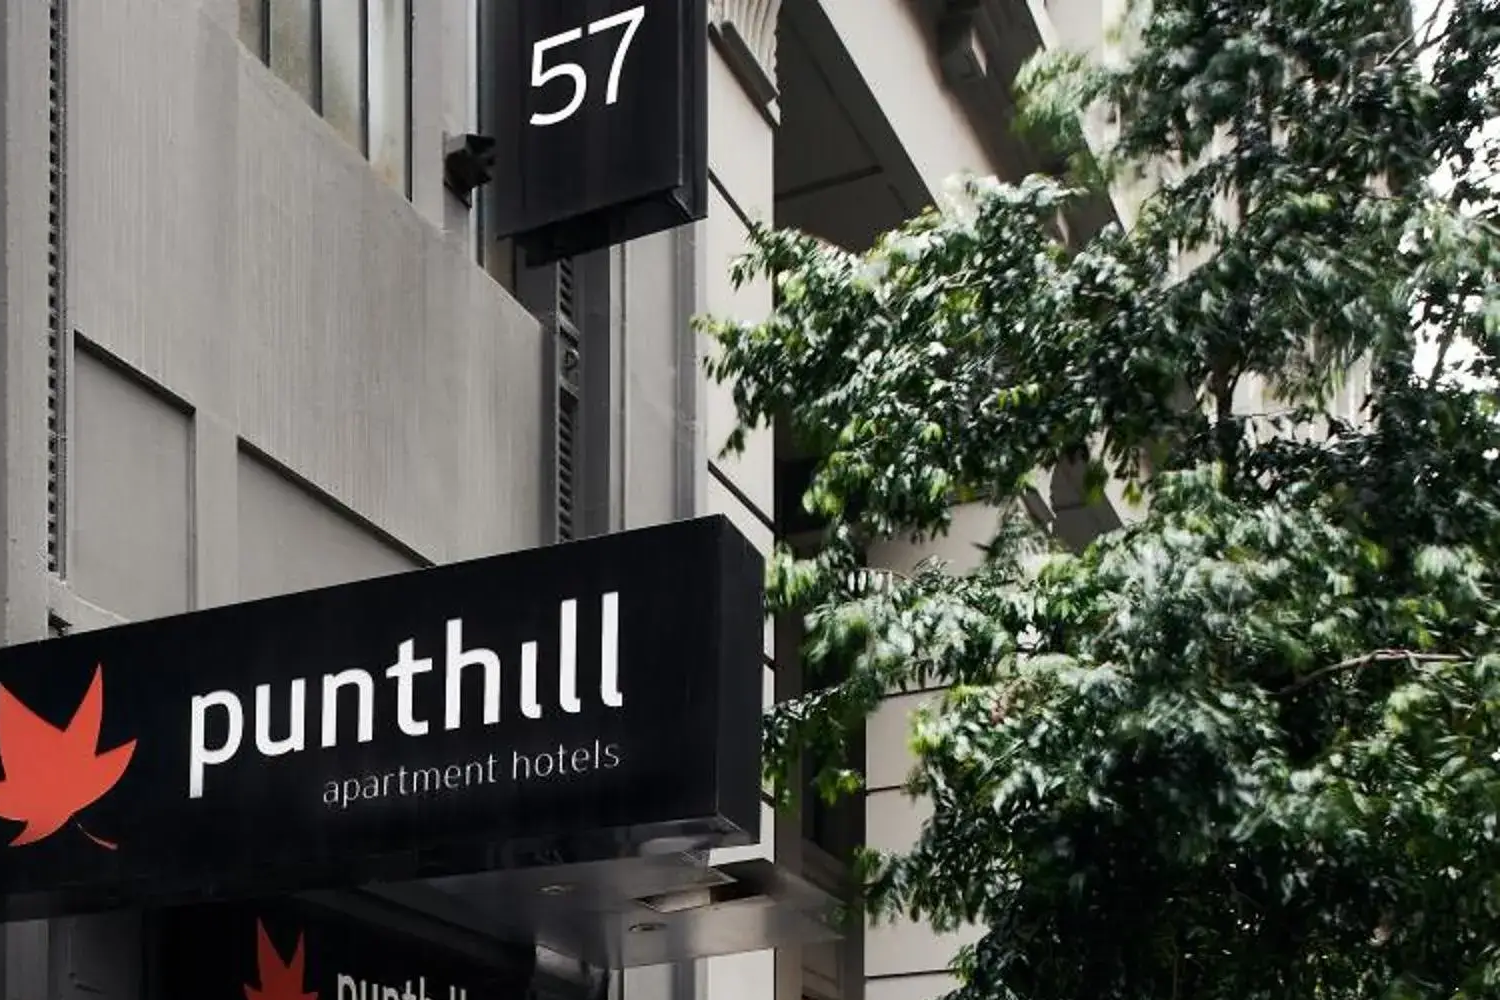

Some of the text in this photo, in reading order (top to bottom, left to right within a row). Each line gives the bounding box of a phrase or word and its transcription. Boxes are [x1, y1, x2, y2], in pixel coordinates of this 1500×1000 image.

[529, 5, 645, 126] 57
[188, 591, 624, 799] punthill
[323, 739, 620, 809] apartment hotels
